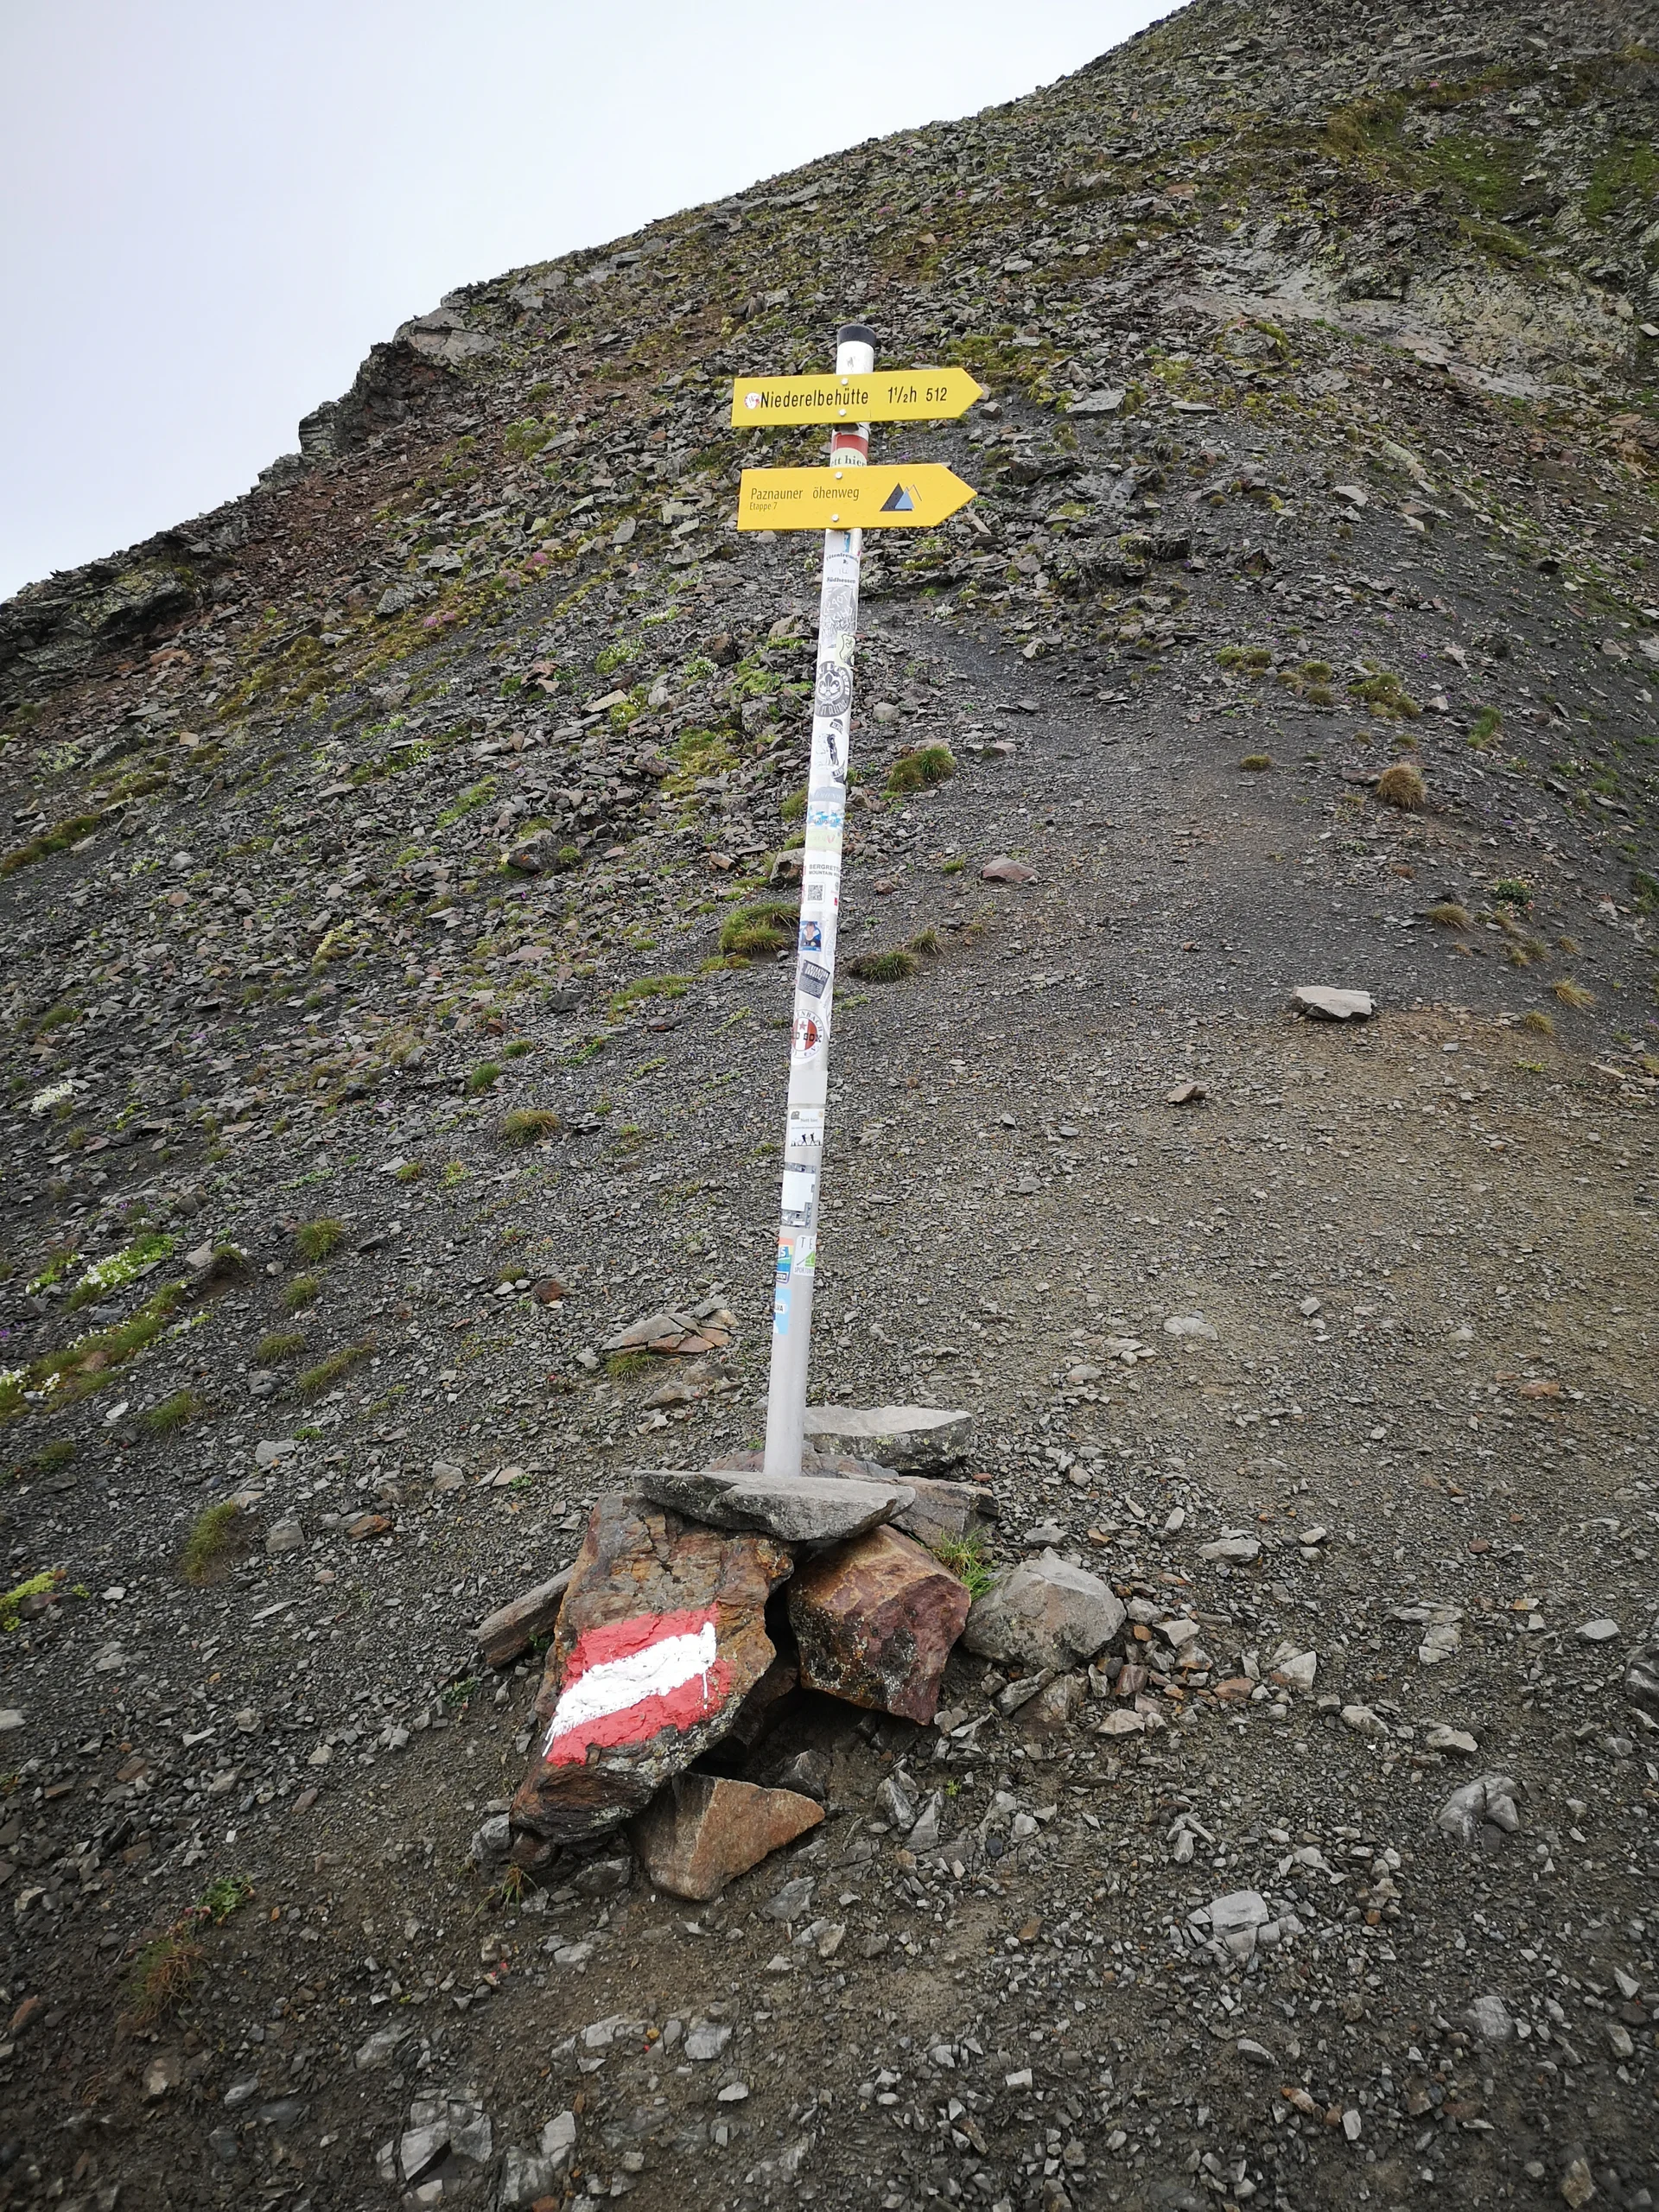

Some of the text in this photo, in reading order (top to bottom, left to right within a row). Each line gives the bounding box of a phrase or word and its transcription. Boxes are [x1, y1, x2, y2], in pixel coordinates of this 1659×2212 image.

[760, 388, 868, 409] Niederelbehütte
[925, 387, 947, 402] 512
[751, 487, 804, 499] Paznauner
[749, 502, 772, 512] Etappe
